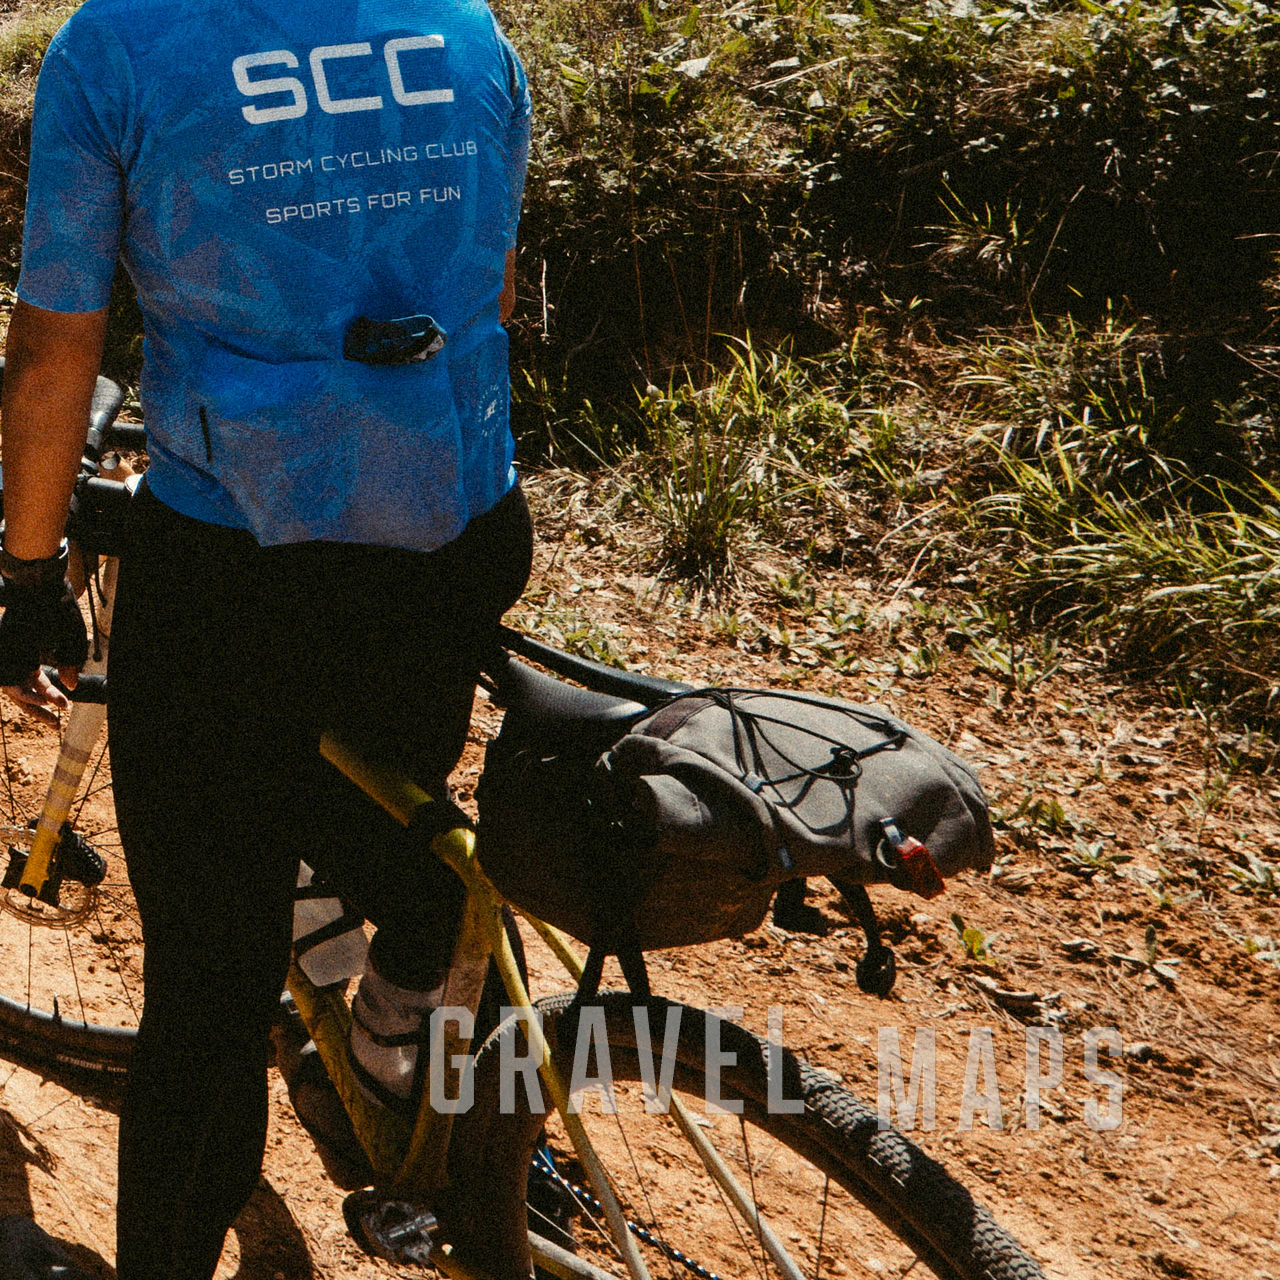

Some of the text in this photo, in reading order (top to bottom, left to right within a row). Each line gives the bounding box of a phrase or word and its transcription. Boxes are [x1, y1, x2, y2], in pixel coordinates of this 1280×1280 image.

[231, 33, 454, 125] SCC
[228, 140, 478, 185] STORM CYCLING CLUB
[265, 185, 461, 224] SPORTS FOR FUN
